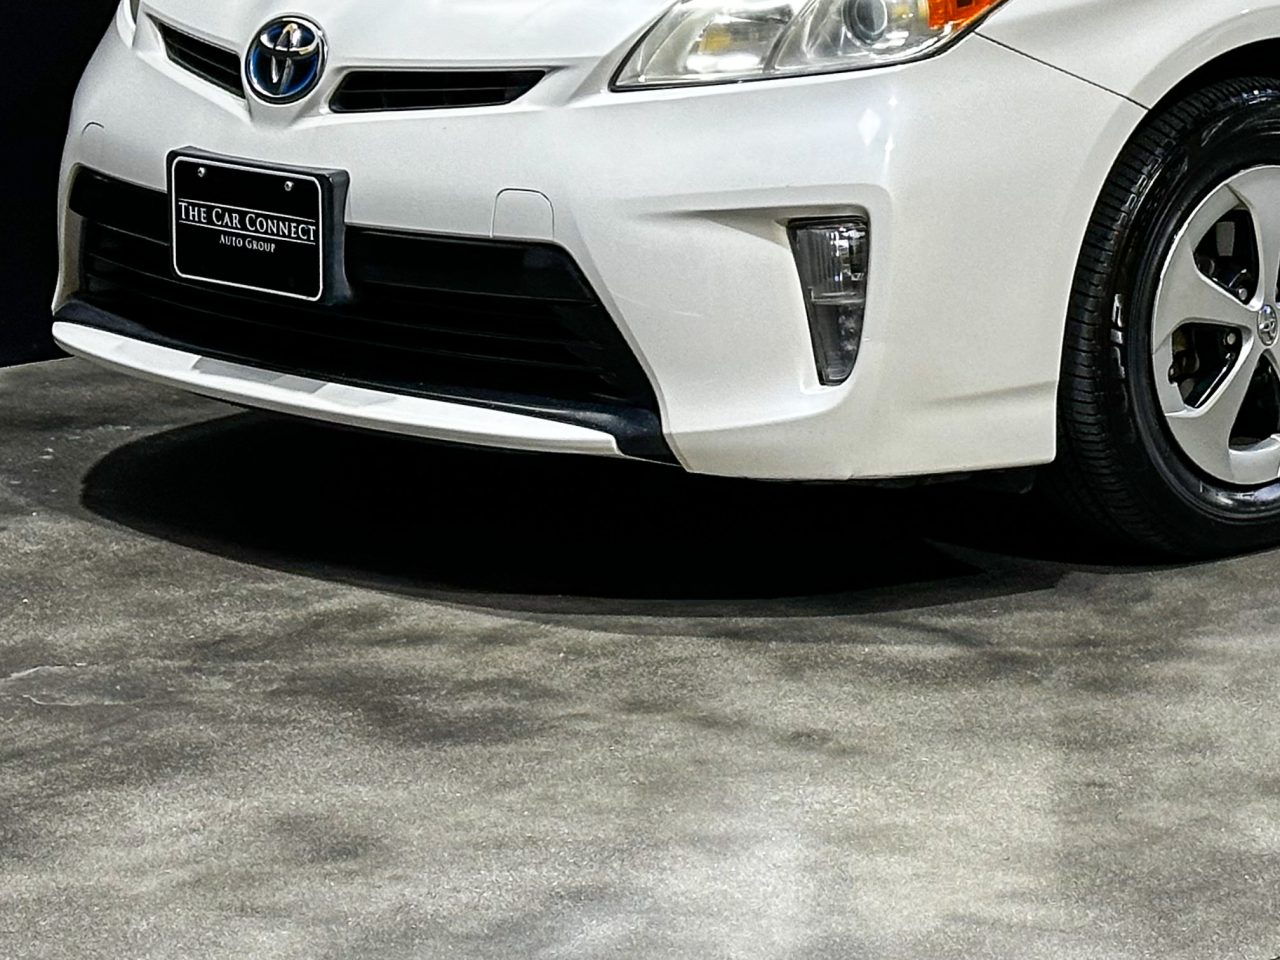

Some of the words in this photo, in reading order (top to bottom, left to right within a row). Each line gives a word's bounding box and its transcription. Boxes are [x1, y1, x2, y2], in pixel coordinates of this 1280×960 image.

[178, 201, 208, 223] THE
[212, 207, 241, 229] CAR
[245, 213, 317, 241] CONNECT
[219, 234, 243, 248] AUTO
[245, 237, 276, 253] GROUP
